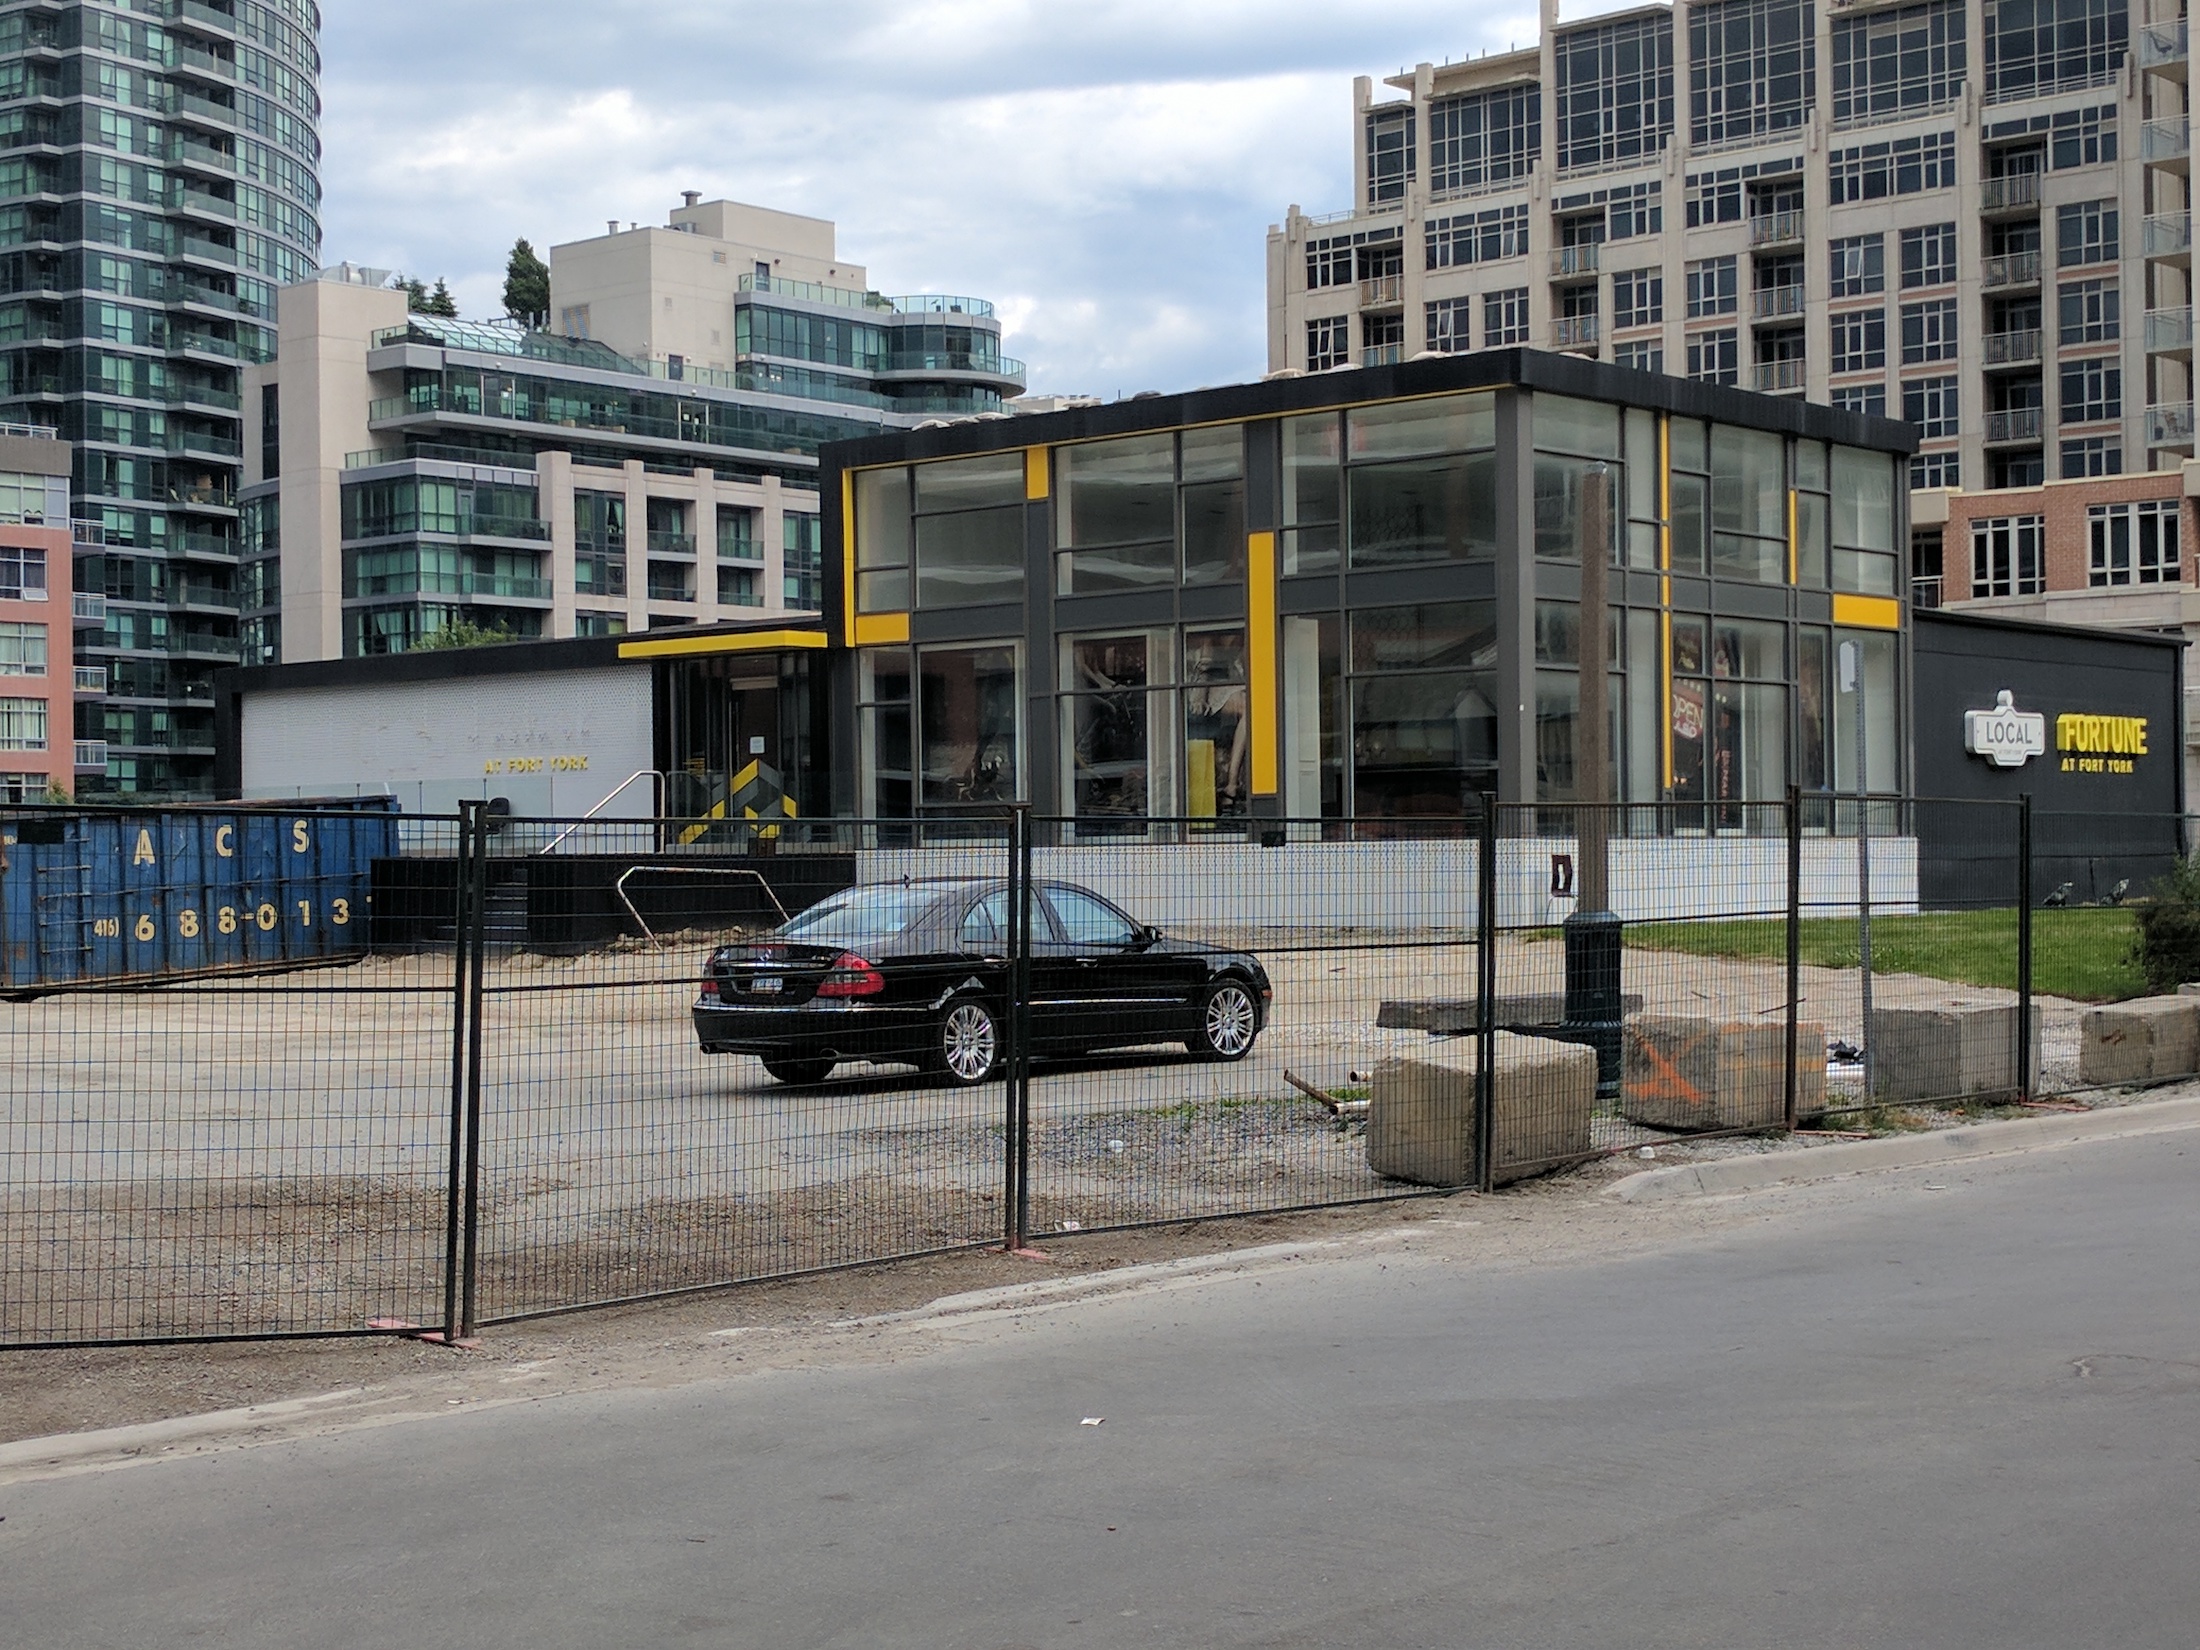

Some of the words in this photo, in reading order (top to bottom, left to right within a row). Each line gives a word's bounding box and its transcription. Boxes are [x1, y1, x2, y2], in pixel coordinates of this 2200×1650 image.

[1986, 721, 2033, 745] LOCAL
[2057, 714, 2148, 754] FORTUNE
[484, 758, 501, 774] AT
[507, 756, 543, 773] FORT
[550, 754, 588, 772] YORK
[2061, 757, 2075, 771] AT
[2079, 758, 2104, 772] FORT
[2107, 759, 2133, 773] YORK
